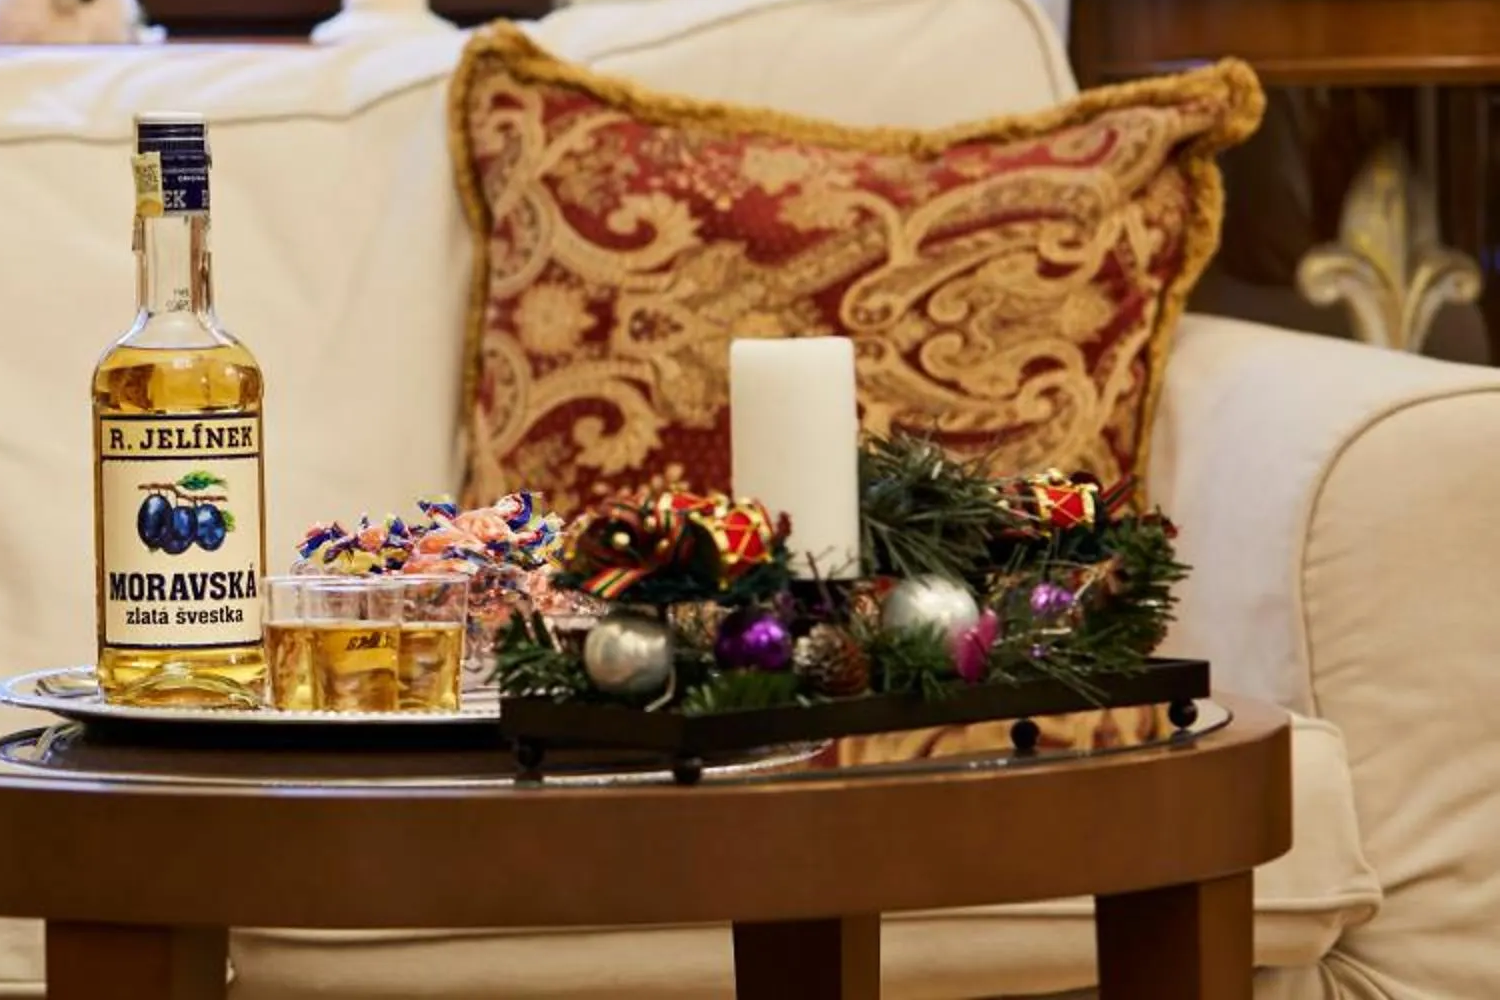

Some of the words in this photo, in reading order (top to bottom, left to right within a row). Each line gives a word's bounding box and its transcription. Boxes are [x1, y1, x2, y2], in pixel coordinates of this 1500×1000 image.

[110, 428, 131, 449] R.
[140, 423, 253, 449] JELÍNEK
[109, 564, 257, 601] MORAVSKÁ
[126, 607, 169, 625] zlatá
[176, 606, 243, 625] švestka
